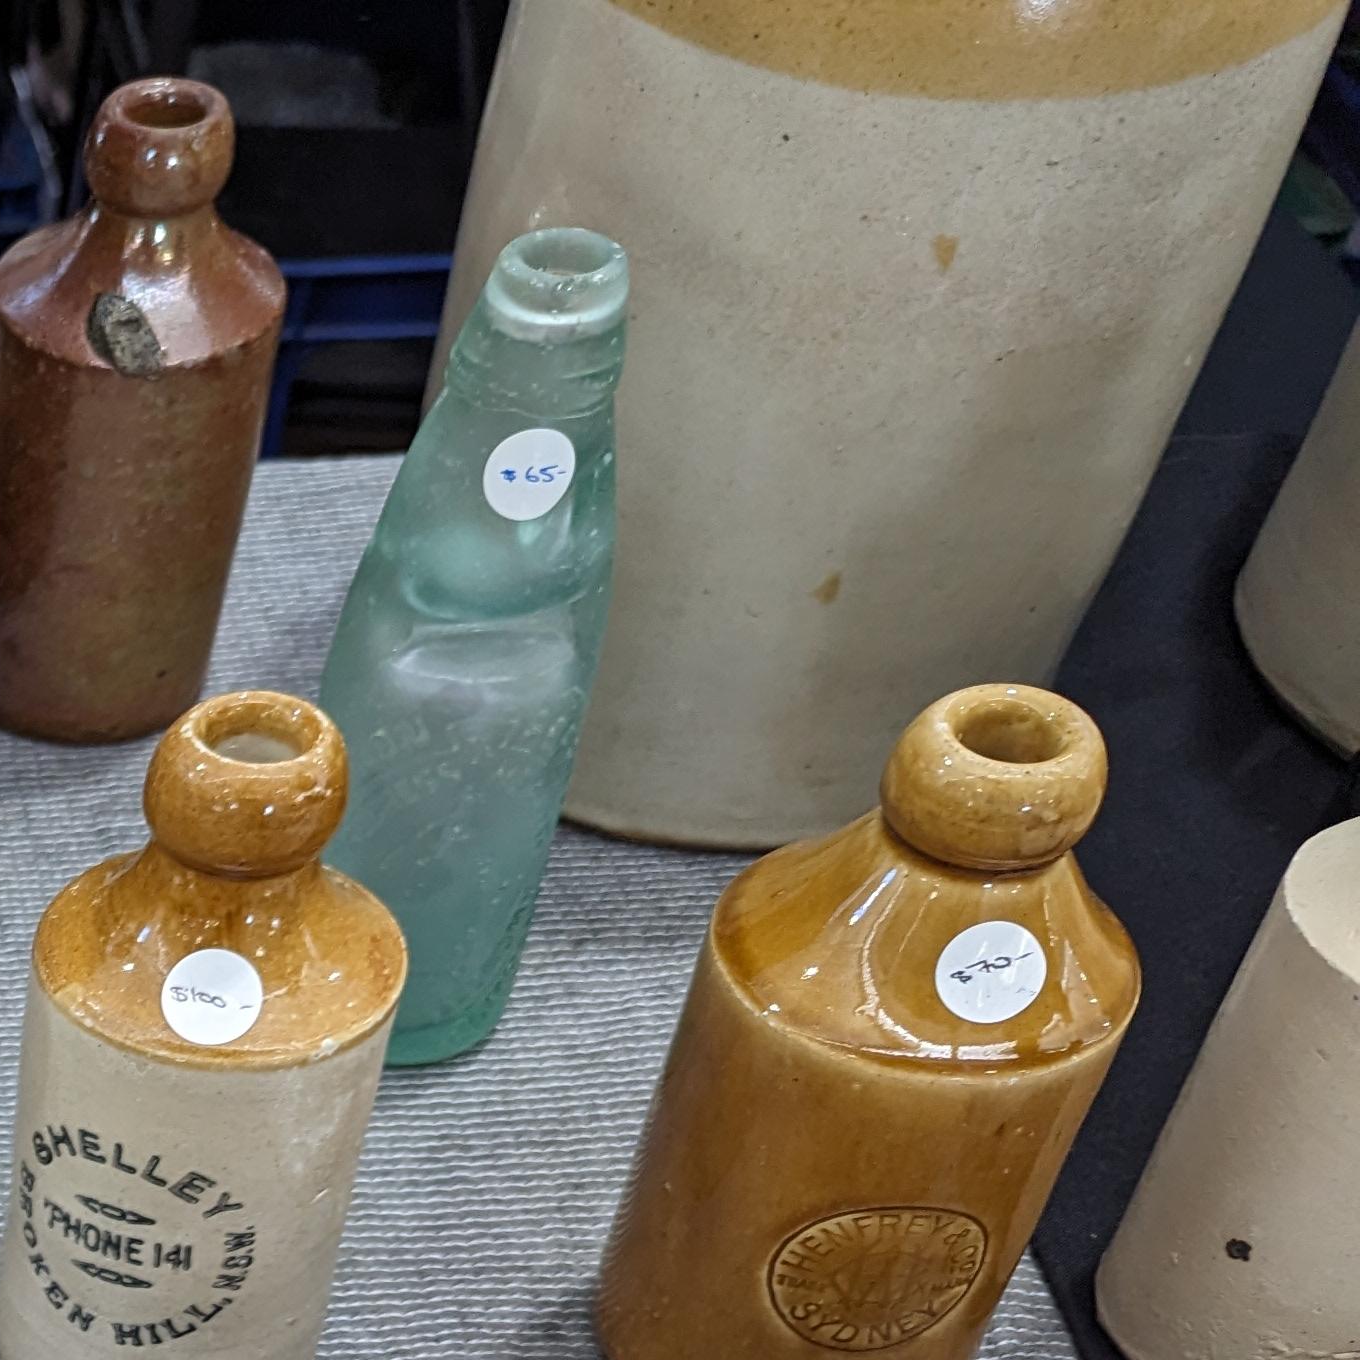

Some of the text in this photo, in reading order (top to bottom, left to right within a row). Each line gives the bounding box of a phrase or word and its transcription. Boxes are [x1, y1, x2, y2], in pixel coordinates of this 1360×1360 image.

[33, 1125, 244, 1220] SHELLEY
[152, 1243, 193, 1271] 141
[779, 1213, 954, 1272] HENFREY
[790, 1301, 938, 1344] SYDNEY
